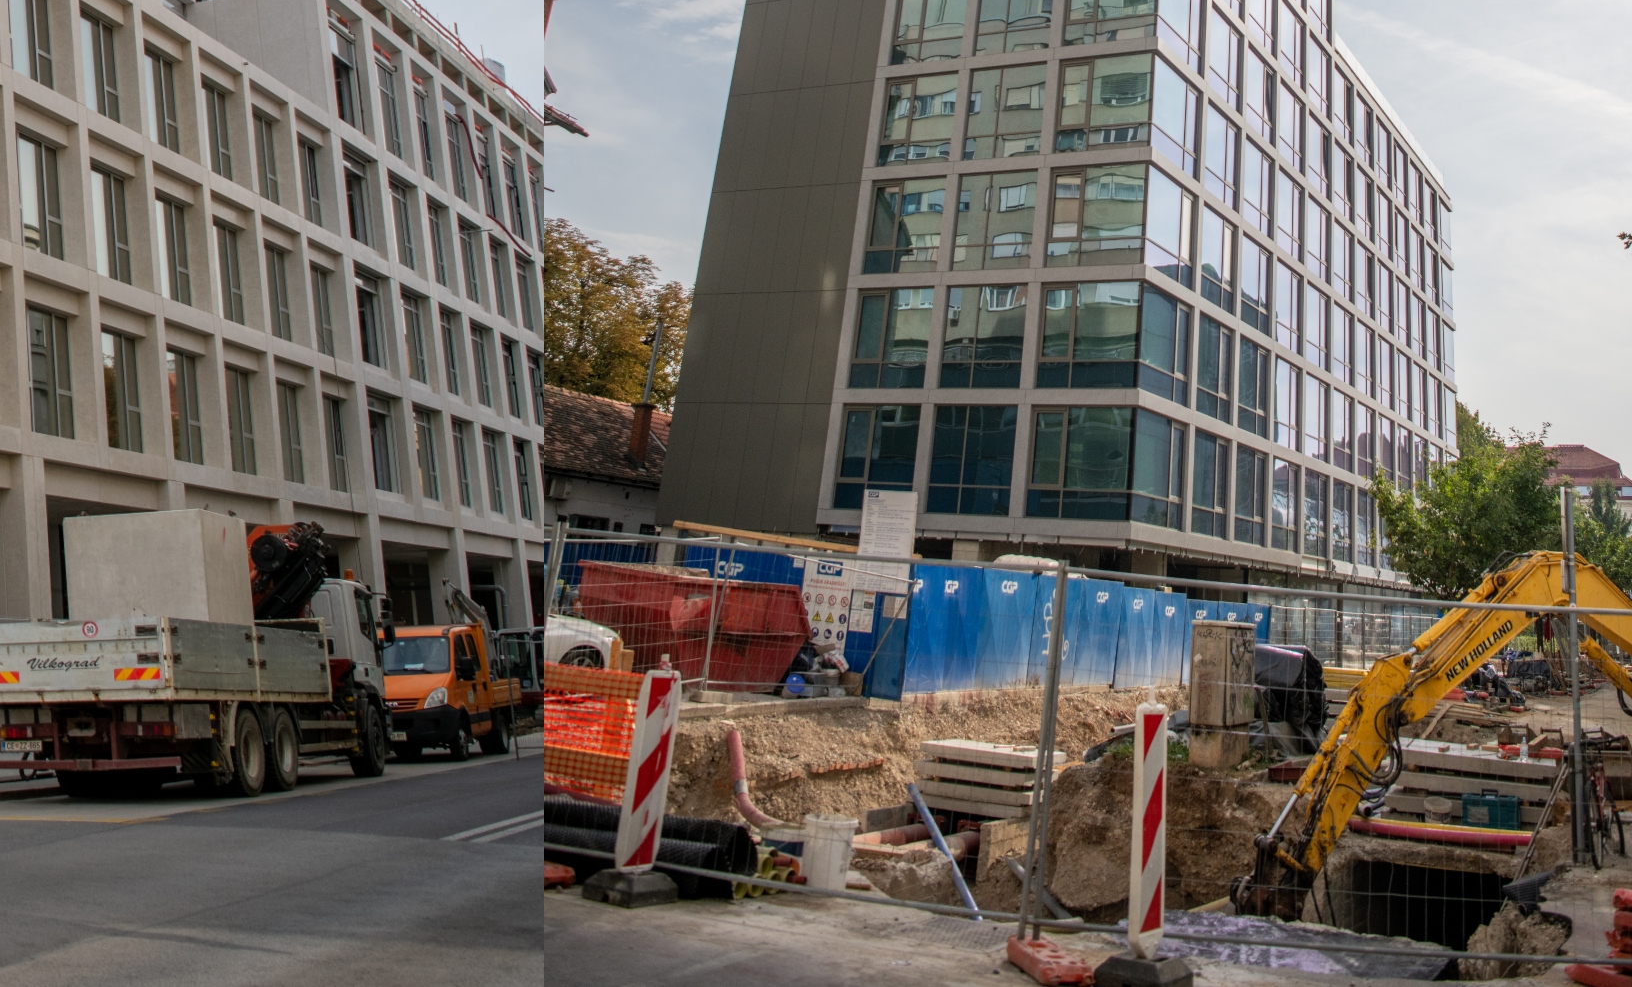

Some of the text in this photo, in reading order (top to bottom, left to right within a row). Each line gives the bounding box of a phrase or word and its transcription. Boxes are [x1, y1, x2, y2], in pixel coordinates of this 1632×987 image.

[718, 560, 744, 577] CGP
[819, 563, 841, 575] CGP
[1001, 580, 1018, 594] CGP
[1096, 591, 1109, 604] CGP
[1133, 598, 1144, 610] CGP
[1165, 606, 1175, 616] CGP
[1195, 610, 1207, 620] CGP
[1228, 611, 1237, 622] CGP
[1254, 612, 1263, 622] CGP
[1445, 619, 1513, 682] NEW HOLLAND
[26, 655, 100, 672] Vilkograd
[6, 741, 15, 750] CE
